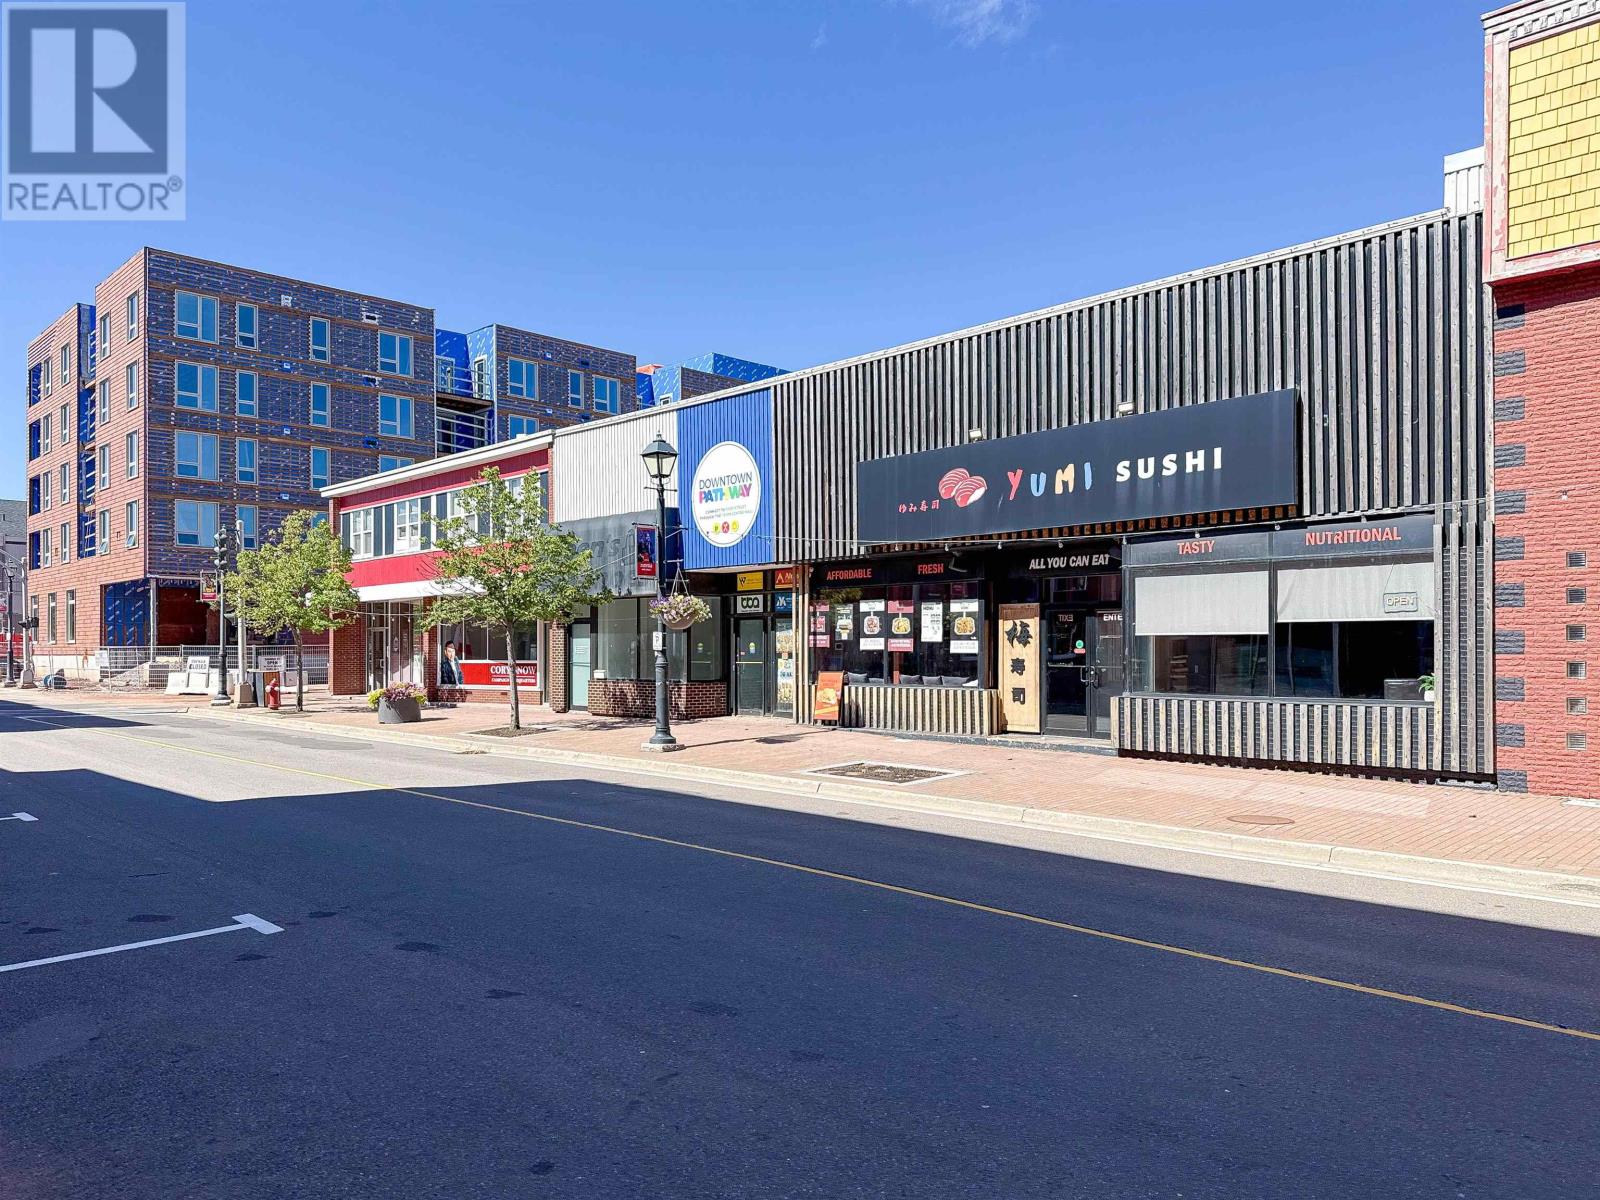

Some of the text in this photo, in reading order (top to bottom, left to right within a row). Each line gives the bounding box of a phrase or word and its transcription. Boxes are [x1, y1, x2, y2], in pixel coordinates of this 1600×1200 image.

[699, 471, 752, 489] DOWNTOWN
[1007, 447, 1222, 500] YUMI SUSHI
[699, 483, 752, 504] PATHWAY
[1305, 526, 1402, 546] NUTRITIONAL
[1176, 540, 1215, 555] TASTY
[917, 563, 944, 575] FRESH
[1029, 553, 1110, 570] ALL YOU CAN EAT
[826, 568, 873, 580] AFFORDABLE
[1386, 596, 1416, 607] OPEN
[1103, 613, 1123, 621] ENTE
[515, 665, 537, 675] NOW
